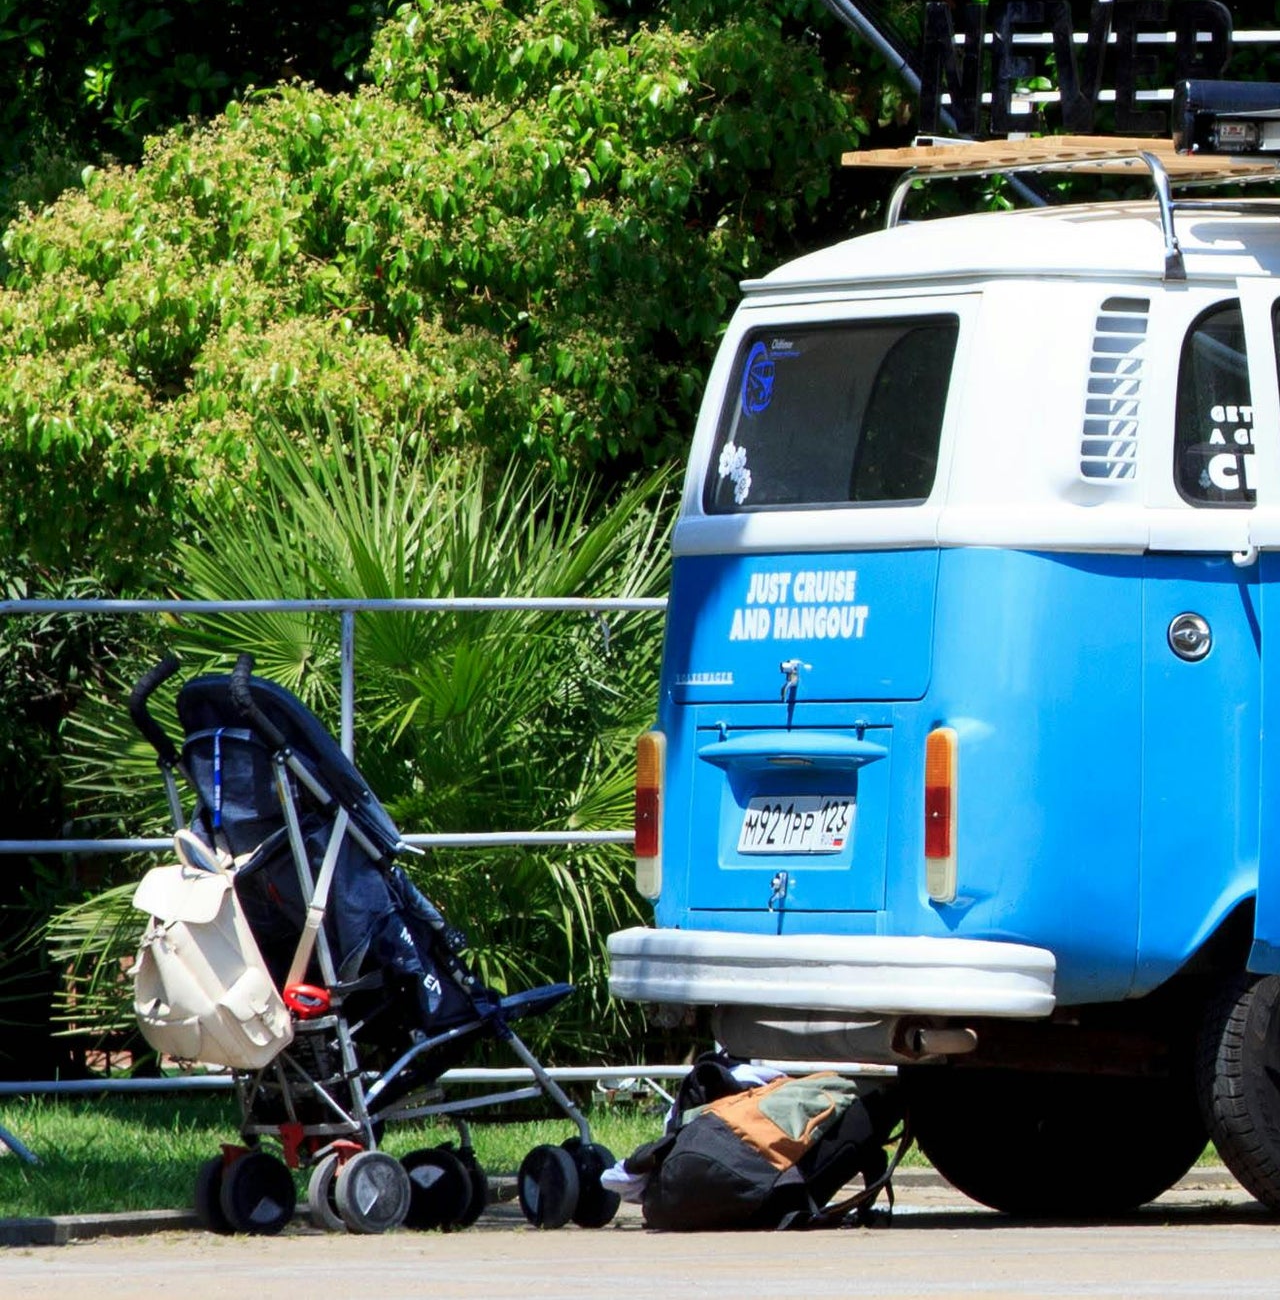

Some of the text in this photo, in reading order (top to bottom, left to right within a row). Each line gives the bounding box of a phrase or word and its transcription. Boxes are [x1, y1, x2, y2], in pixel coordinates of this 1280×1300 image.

[1210, 406, 1252, 423] GET
[1209, 428, 1226, 445] A
[746, 570, 857, 604] JUST CRUISE
[729, 606, 869, 641] AND HANGOUT
[821, 801, 849, 832] 123
